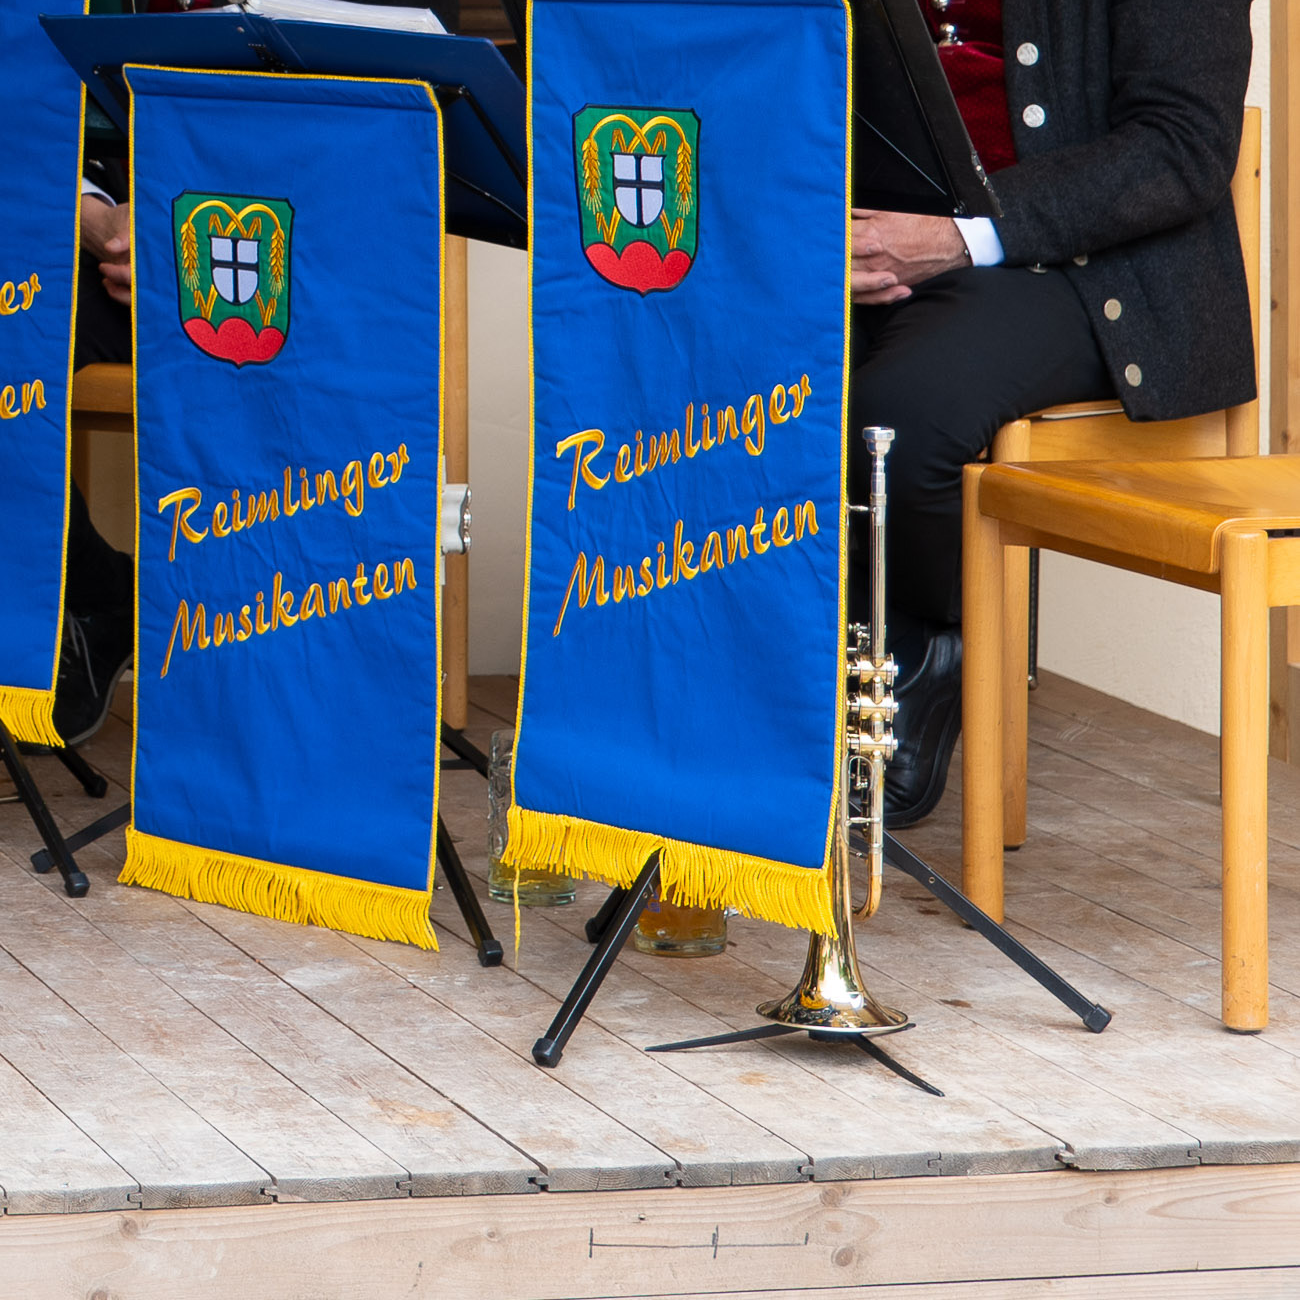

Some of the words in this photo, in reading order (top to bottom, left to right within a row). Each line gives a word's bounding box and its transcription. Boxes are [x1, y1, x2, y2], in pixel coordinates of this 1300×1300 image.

[157, 443, 410, 562] Reimlinger
[556, 374, 812, 511] Reimlinger
[160, 558, 417, 677] Musikanten
[553, 500, 819, 637] Musikanten
